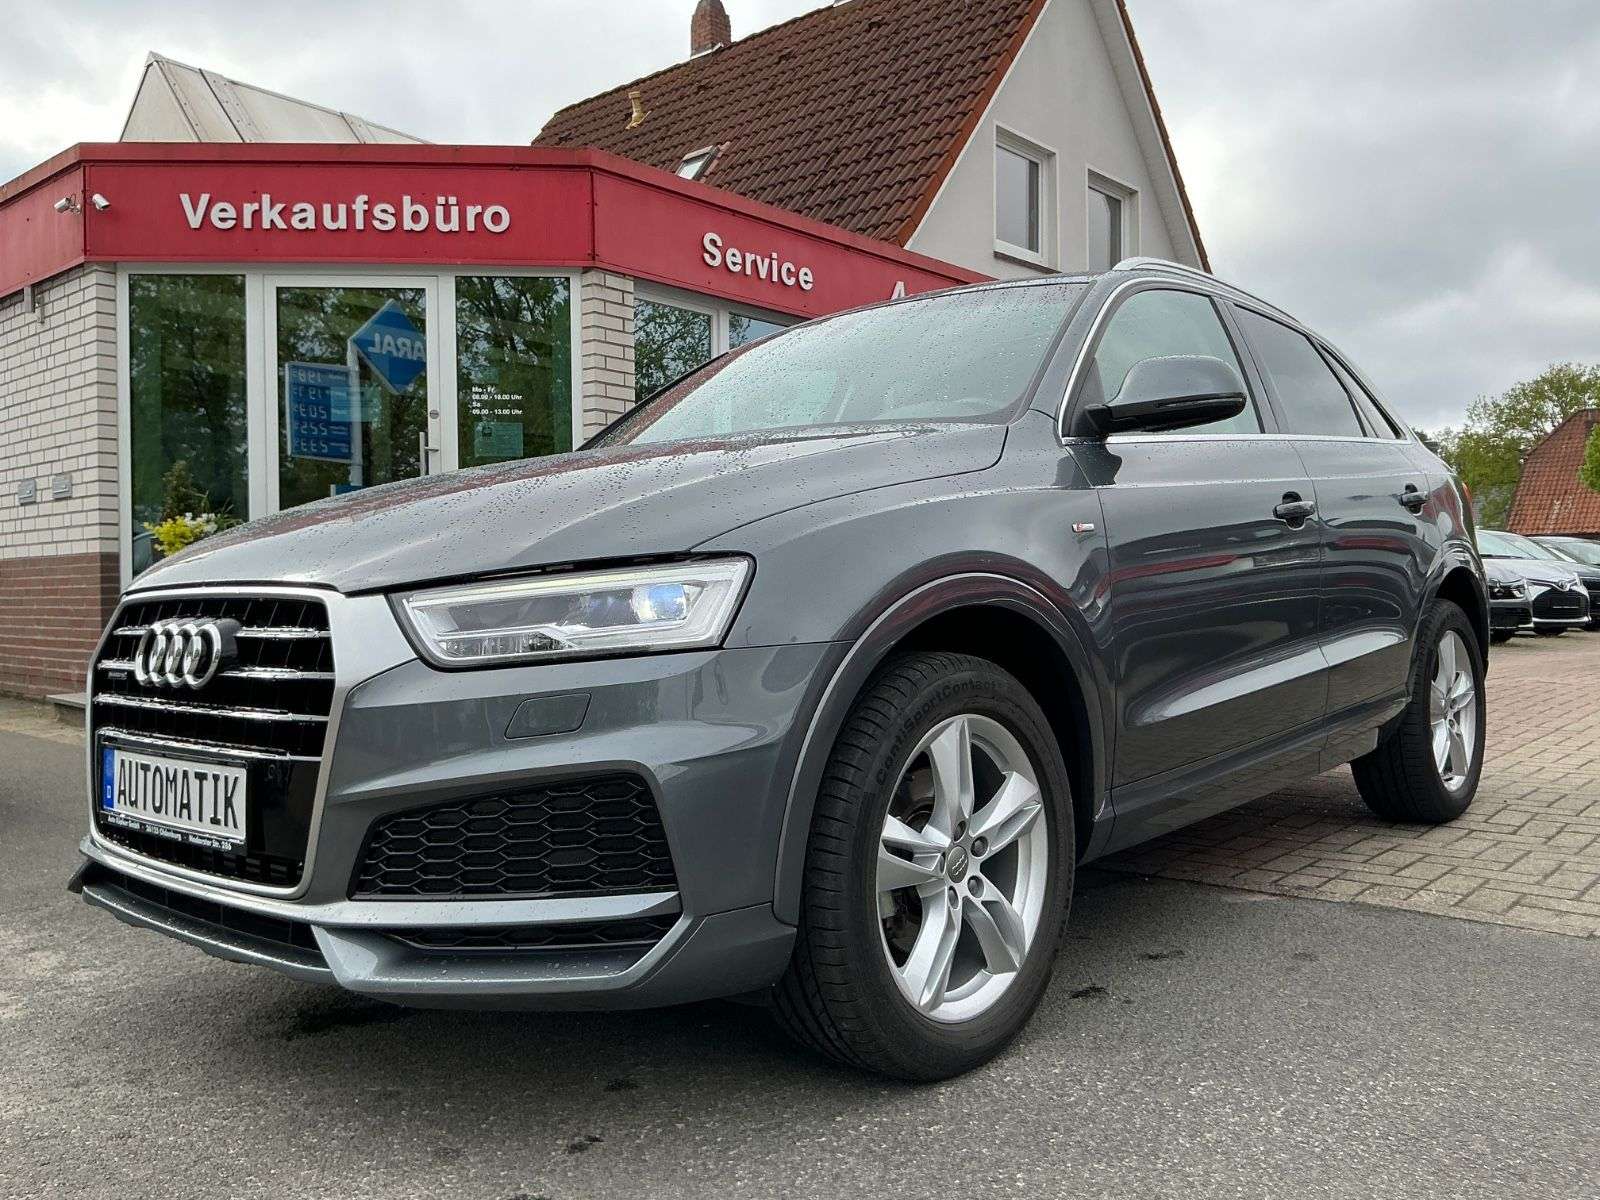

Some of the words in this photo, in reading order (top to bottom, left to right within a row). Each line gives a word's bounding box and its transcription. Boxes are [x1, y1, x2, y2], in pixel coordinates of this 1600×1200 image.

[179, 193, 511, 233] Verkaufsbüro
[702, 232, 814, 291] Service
[118, 759, 239, 830] AUTOMATIK
